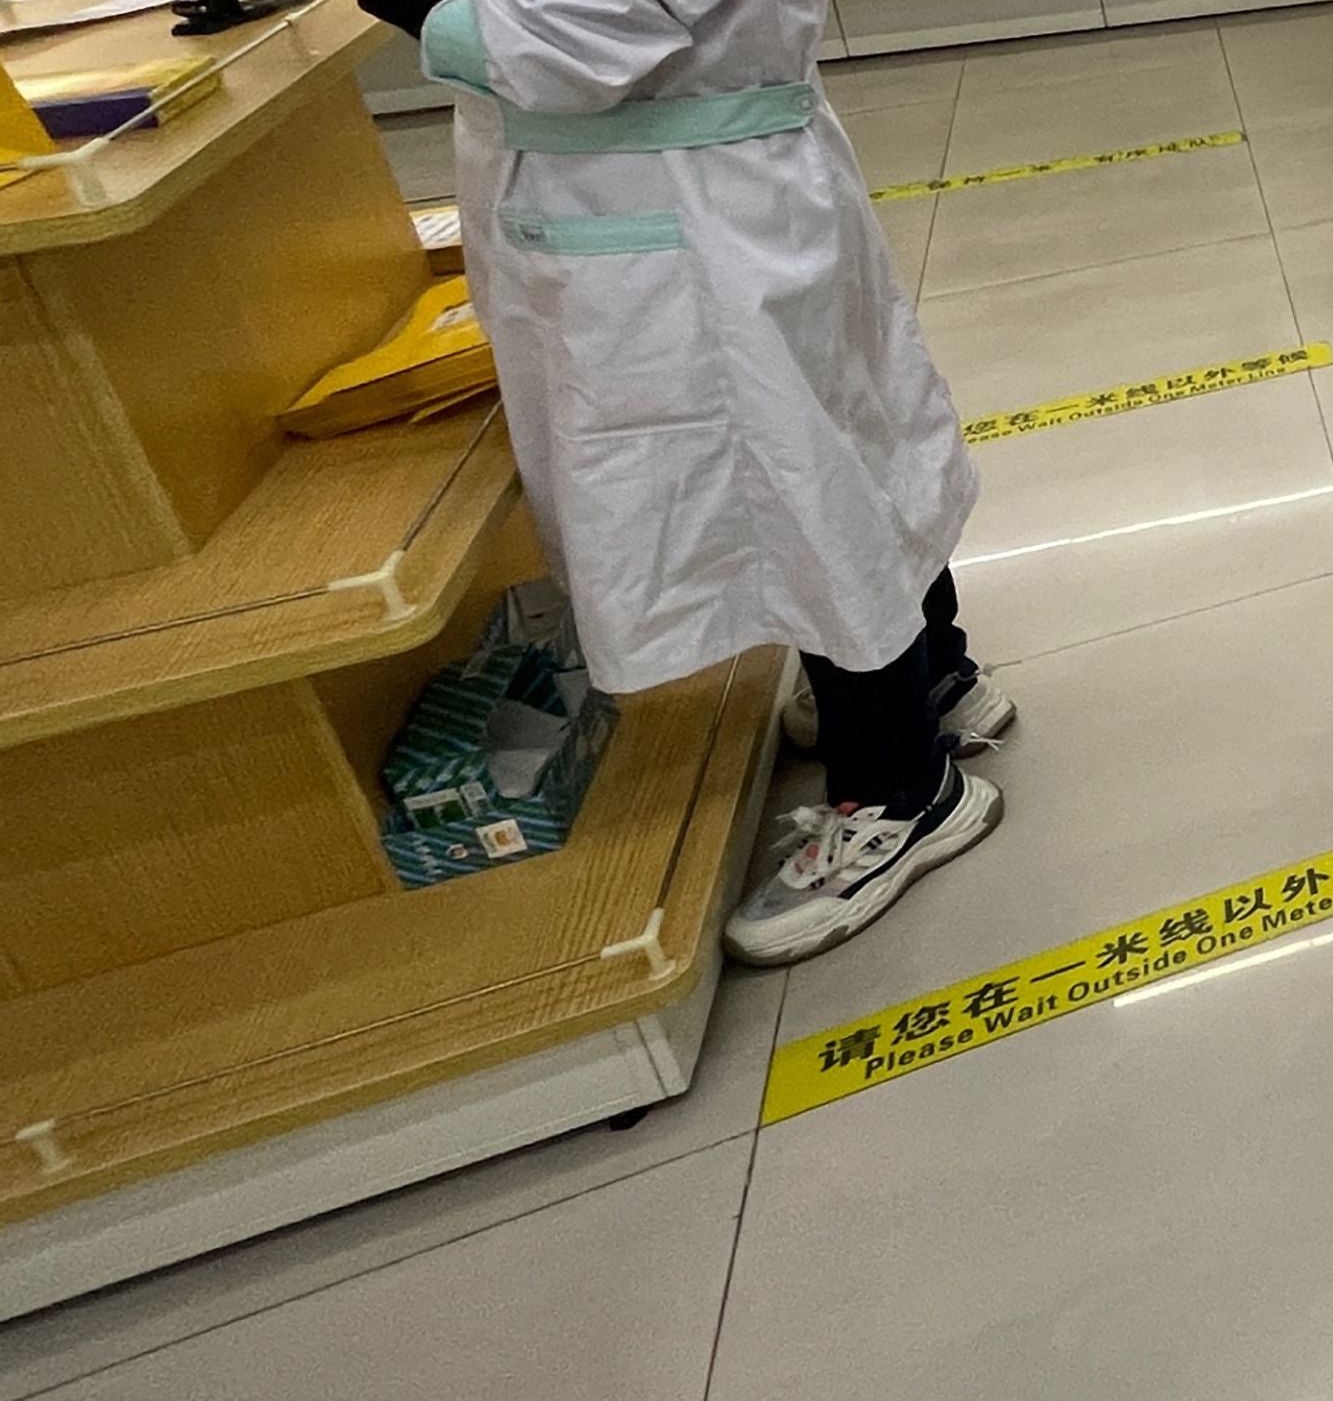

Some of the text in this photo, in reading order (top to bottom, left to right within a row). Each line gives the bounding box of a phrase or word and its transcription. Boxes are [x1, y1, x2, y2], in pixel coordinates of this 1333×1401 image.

[963, 349, 1309, 437] 您在一米线以外等候
[967, 366, 1286, 444] ease Wait Outside One Meter Line
[863, 1026, 976, 1081] Please
[983, 990, 1060, 1033] Wait
[1067, 946, 1189, 1002] Outside
[1195, 922, 1255, 956] One
